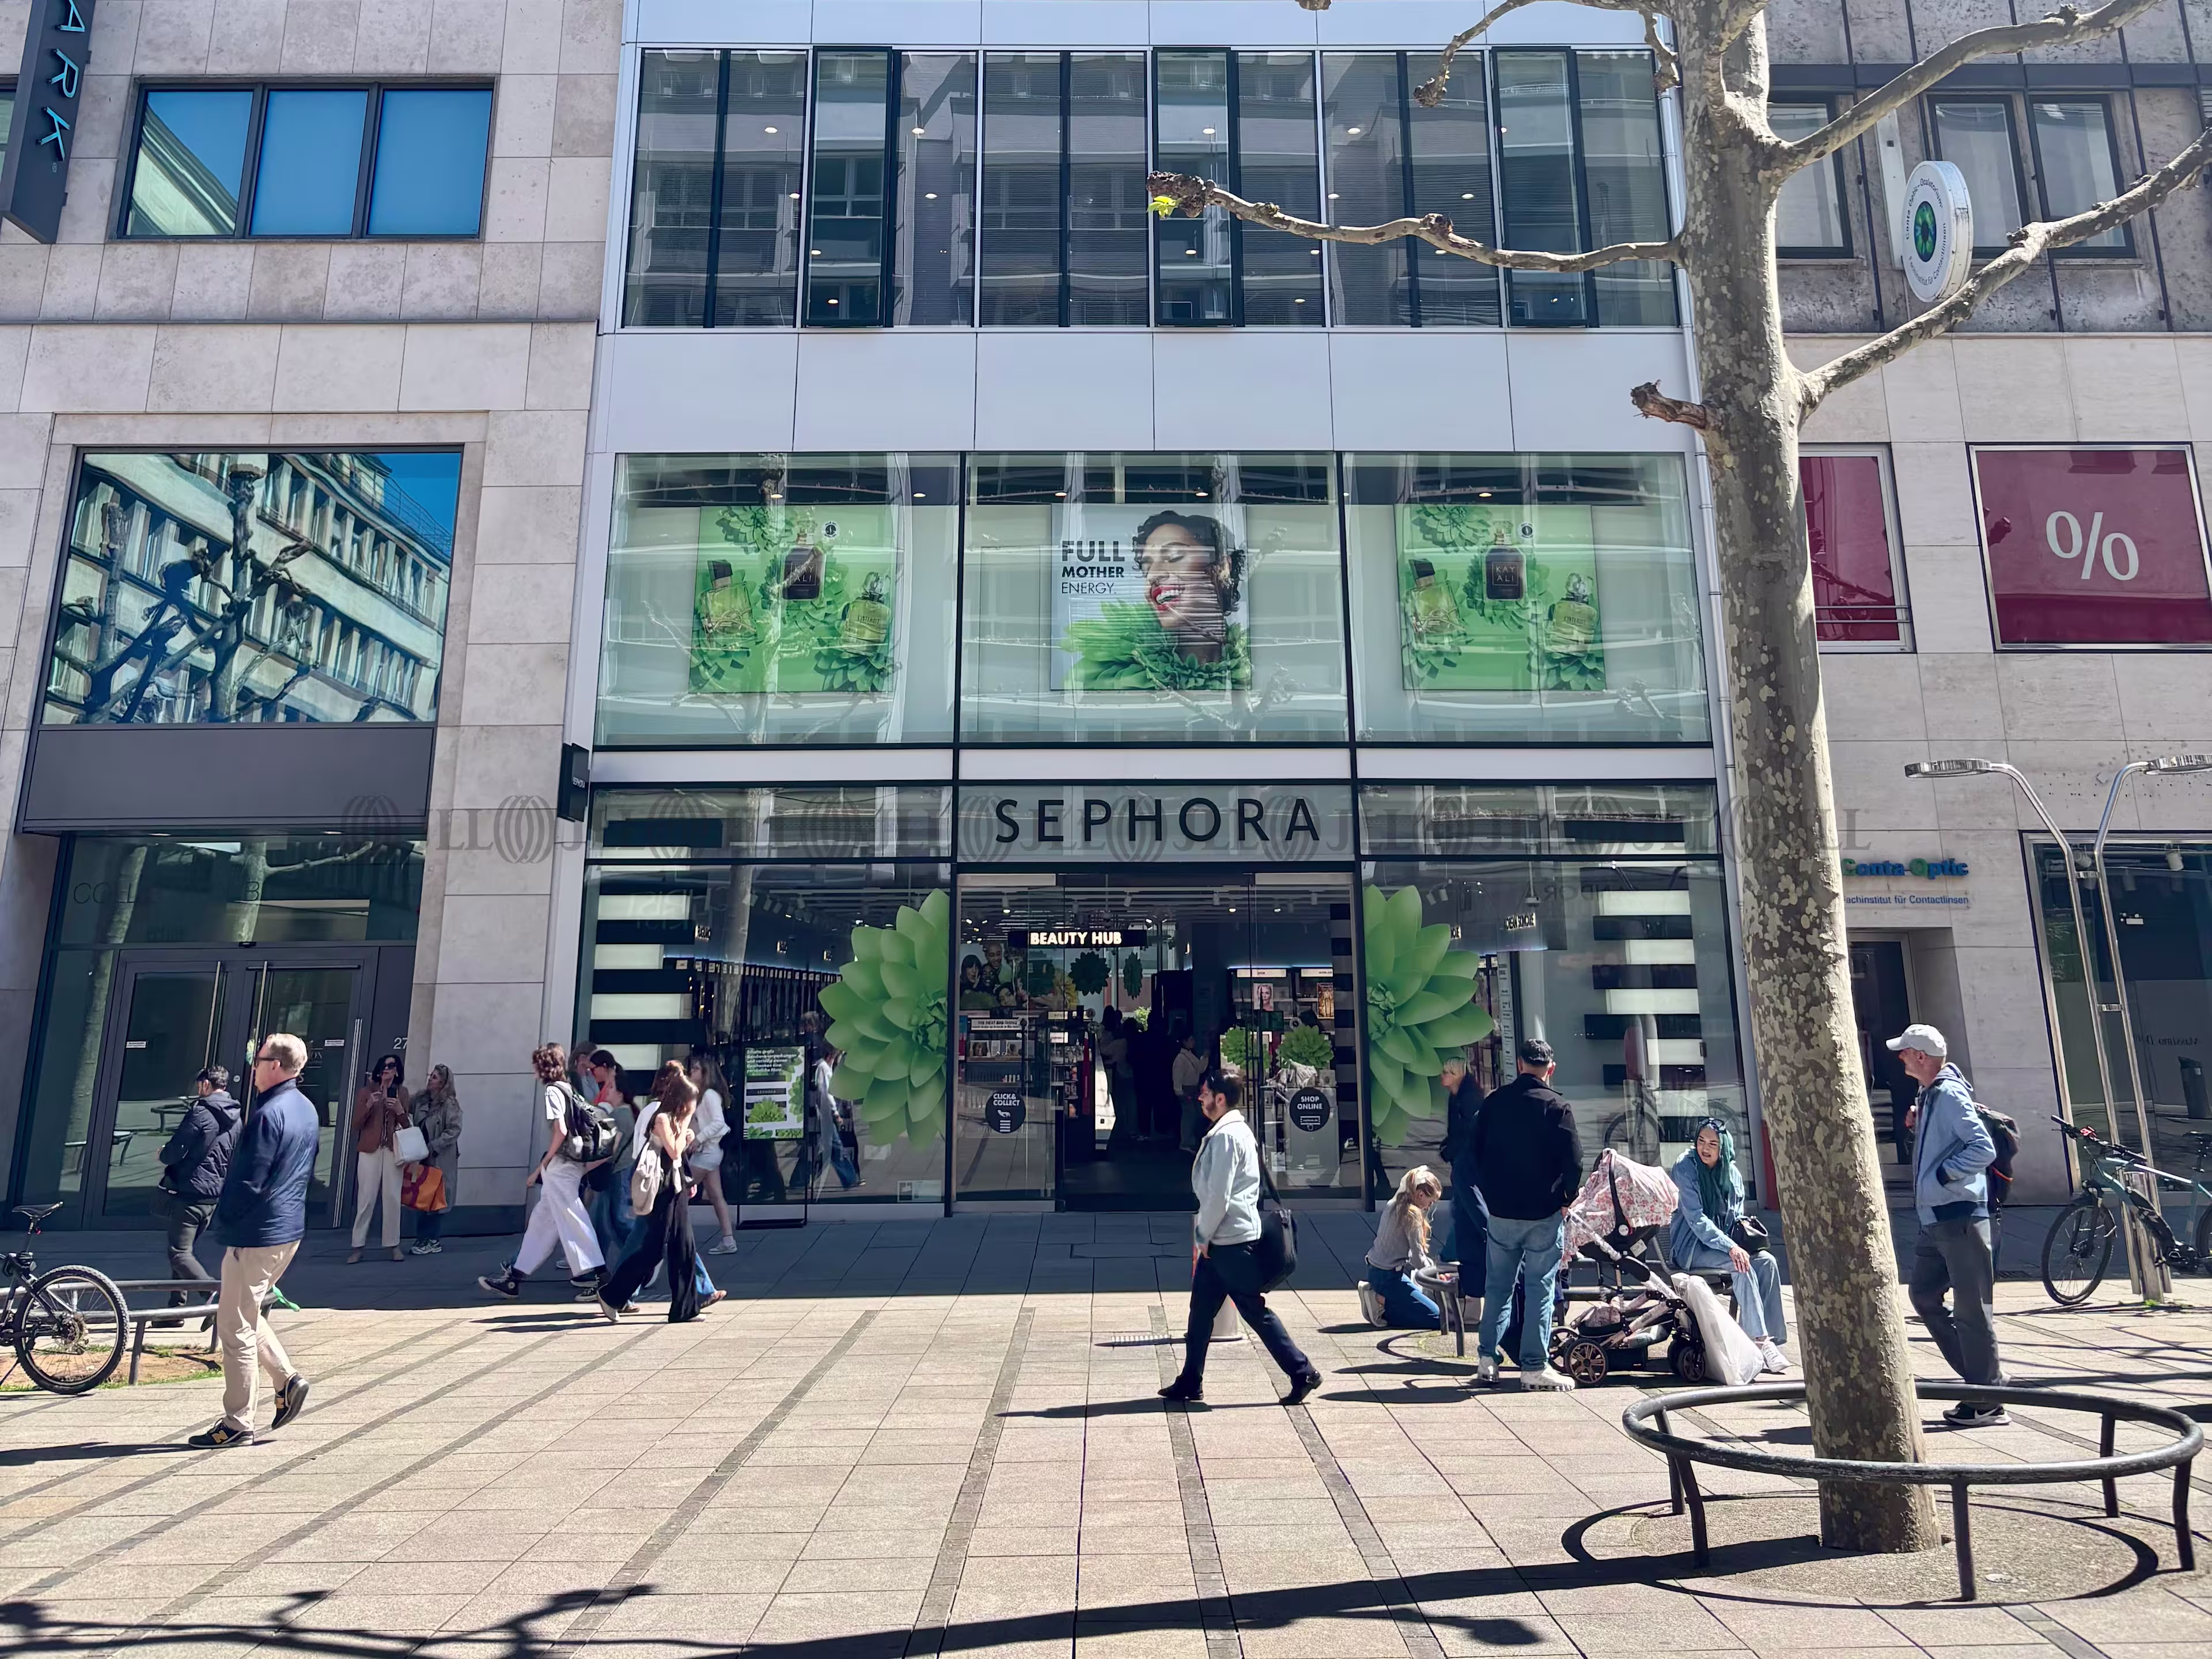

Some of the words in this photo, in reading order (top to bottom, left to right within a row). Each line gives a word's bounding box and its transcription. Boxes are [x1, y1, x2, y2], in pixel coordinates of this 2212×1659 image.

[1061, 540, 1126, 562] FULL
[2046, 510, 2139, 581] %
[1061, 566, 1125, 578] MOTHER
[1496, 565, 1515, 573] KAY
[1061, 582, 1117, 594] ENERGY.
[995, 797, 1320, 843] SEPHORA
[1844, 895, 1892, 904] achinstitut
[1894, 895, 1907, 904] für
[1909, 895, 1969, 904] Contactlinsen
[1030, 931, 1088, 945] BEAUTY
[1092, 931, 1122, 945] HUB
[393, 1037, 408, 1050] 27
